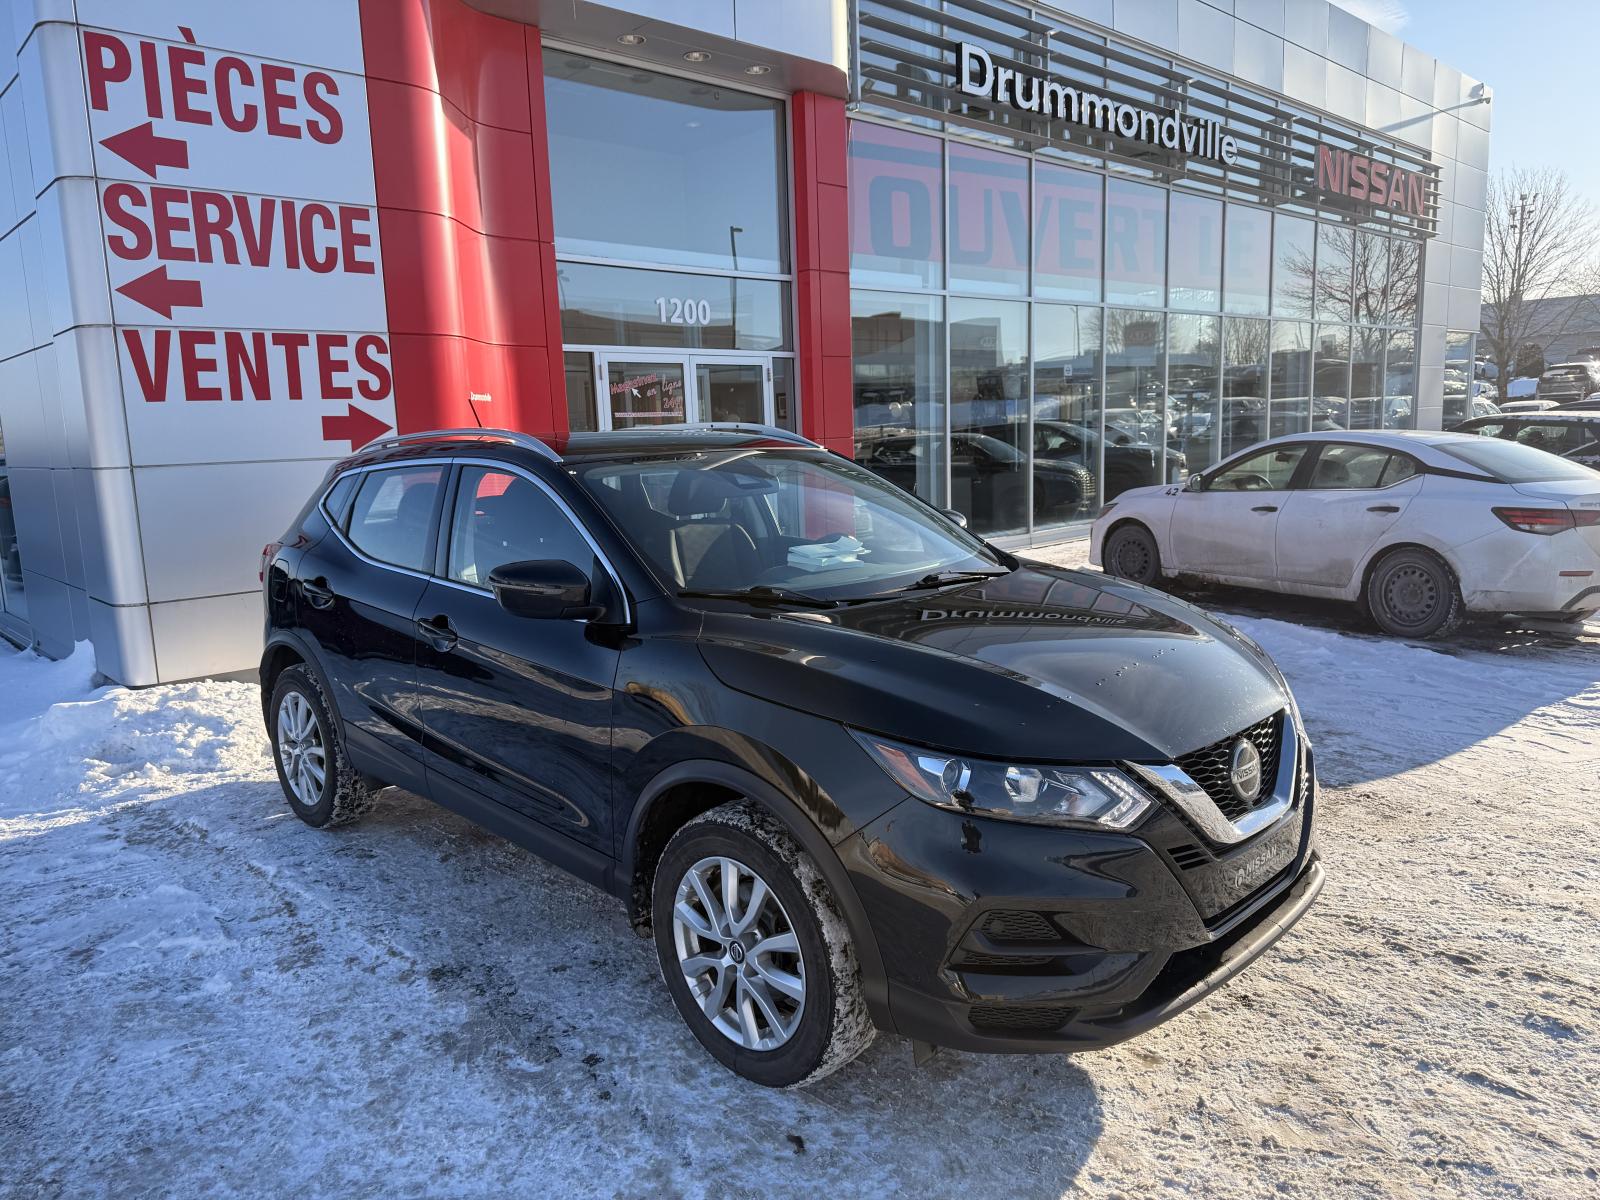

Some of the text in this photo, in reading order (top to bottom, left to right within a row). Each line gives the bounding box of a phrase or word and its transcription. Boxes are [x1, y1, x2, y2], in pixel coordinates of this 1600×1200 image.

[83, 25, 343, 145] PIÈCES
[957, 42, 1239, 165] Drummondville
[1316, 144, 1425, 216] NISSAN
[103, 183, 375, 275] SERVICE
[868, 174, 1172, 274] OUVERT
[656, 296, 711, 325] 1200
[122, 329, 391, 402] VENTES
[1165, 487, 1179, 496] 42
[1247, 845, 1277, 873] NISSAN
